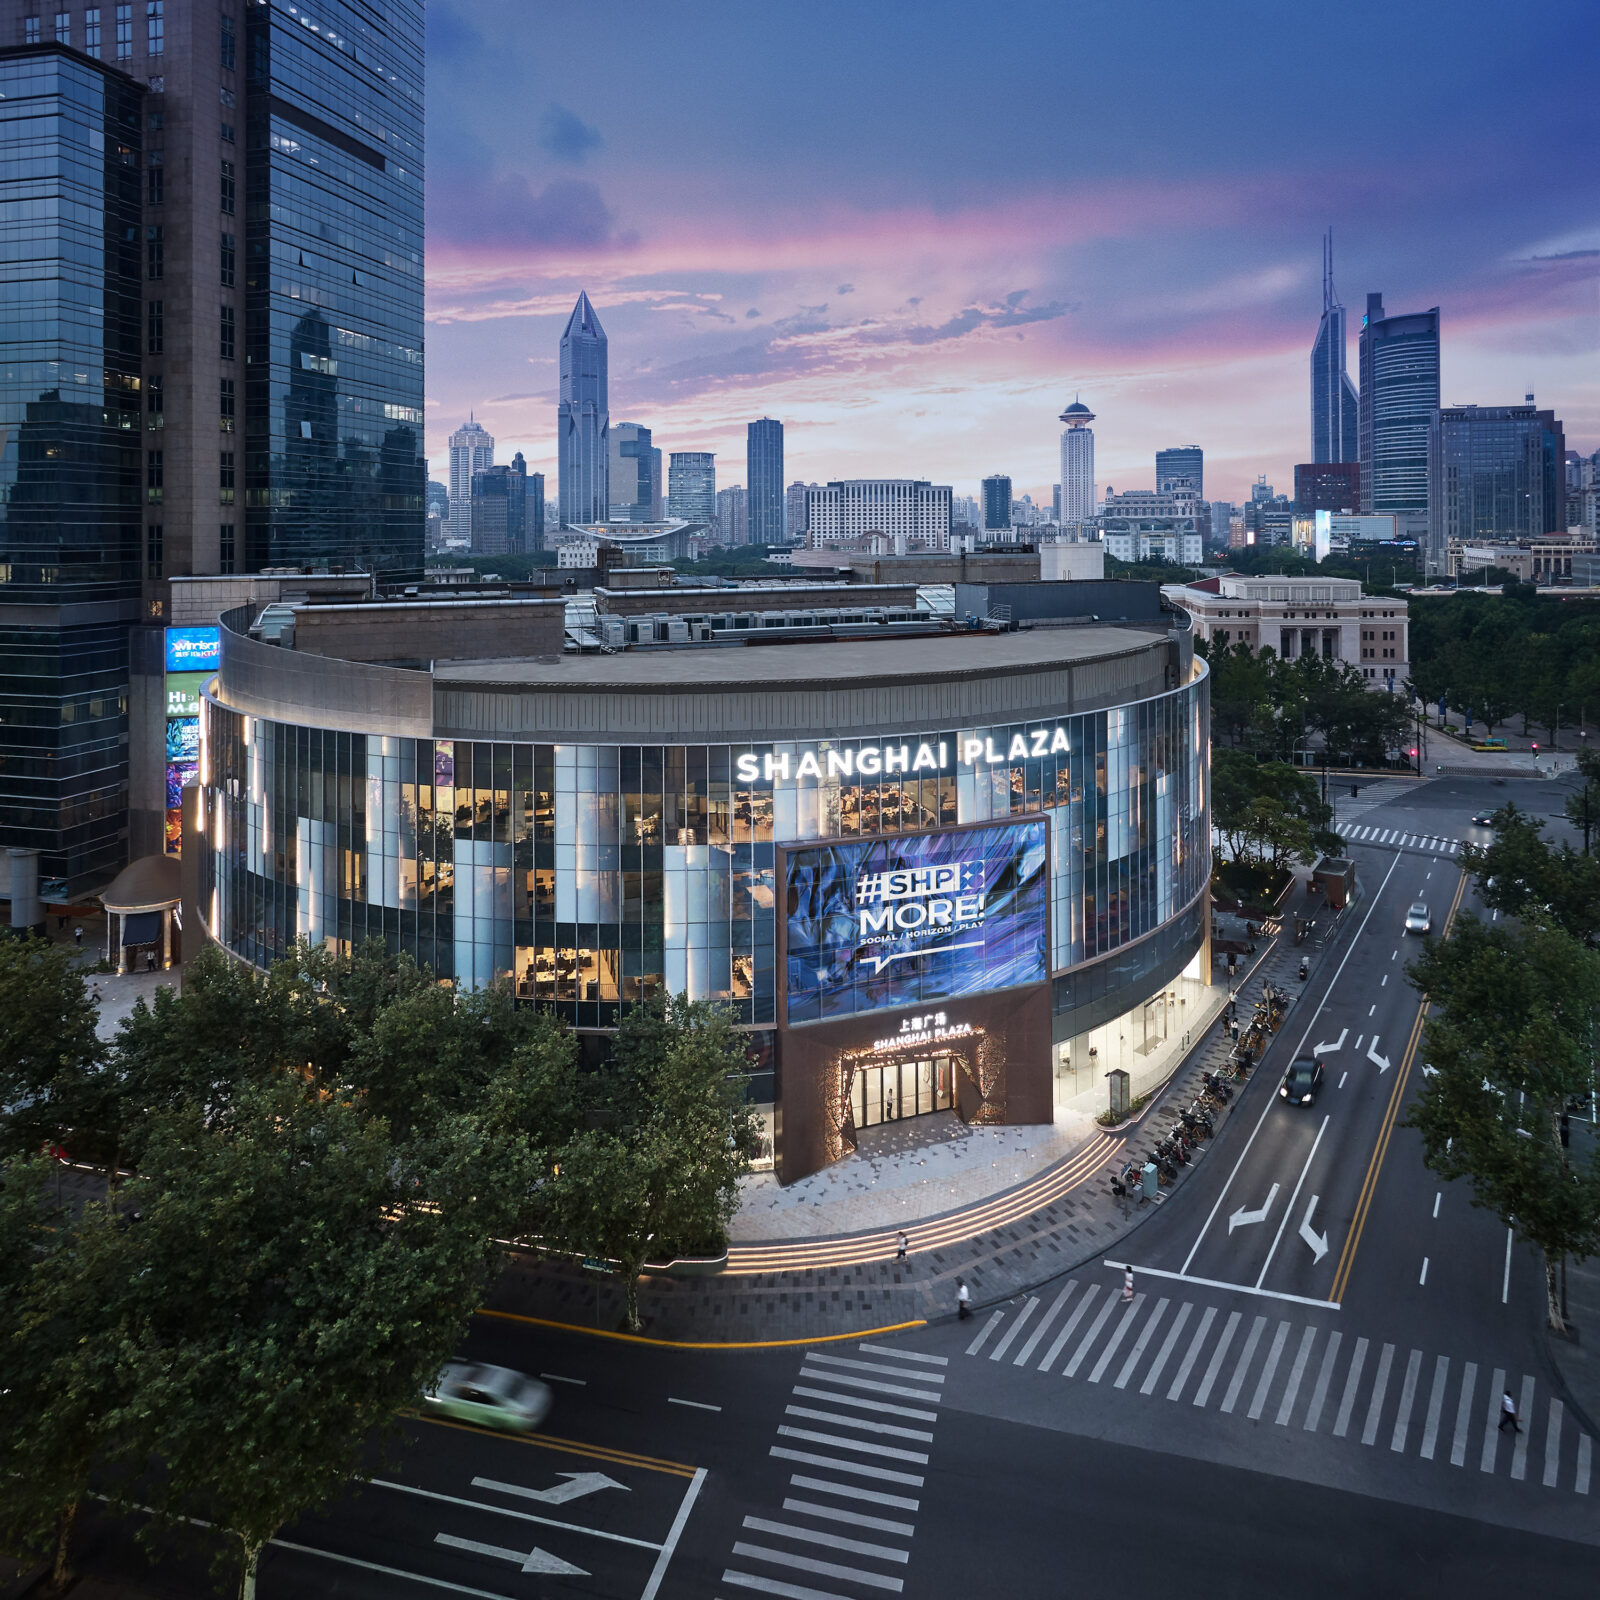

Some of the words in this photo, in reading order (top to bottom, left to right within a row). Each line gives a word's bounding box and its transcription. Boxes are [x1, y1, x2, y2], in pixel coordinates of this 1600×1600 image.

[736, 741, 948, 783] SHANGHAI
[963, 727, 1071, 767] PLAZA
[859, 893, 985, 936] MORE!
[860, 934, 898, 946] SOCIAL
[905, 925, 951, 939] HORIZON
[959, 920, 985, 931] PLAY
[873, 1030, 932, 1051] SHANGHAI
[934, 1022, 972, 1039] PLAZA
